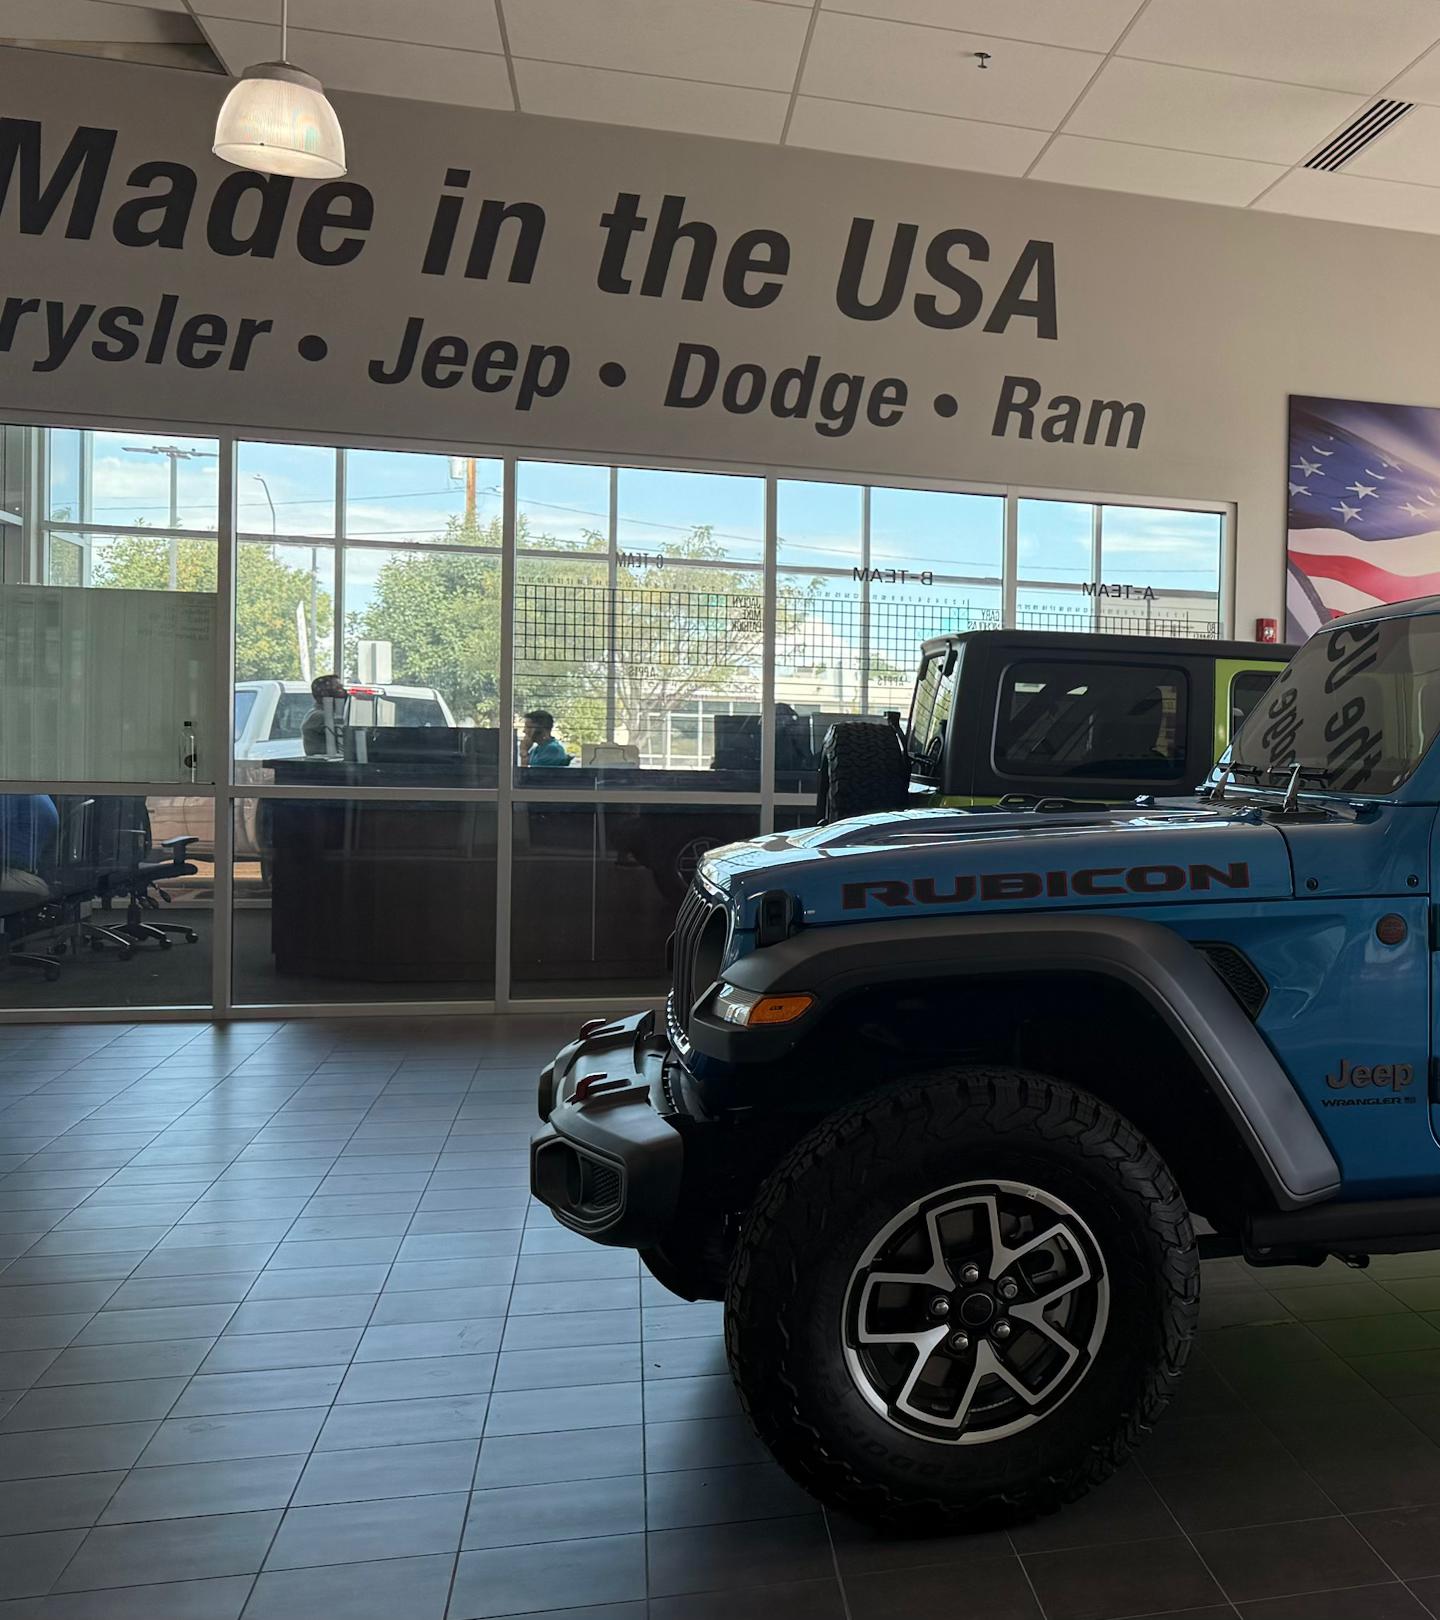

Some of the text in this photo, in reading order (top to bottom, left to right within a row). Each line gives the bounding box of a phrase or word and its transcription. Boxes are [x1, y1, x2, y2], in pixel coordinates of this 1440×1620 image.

[0, 117, 1058, 340] Made in the USA
[368, 317, 570, 410] Jeep
[664, 342, 909, 437] Dodge
[991, 376, 1146, 449] Ram
[842, 862, 1250, 910] RUBICON
[1325, 1058, 1414, 1092] Jeep
[1320, 1097, 1402, 1107] WRANGLER
